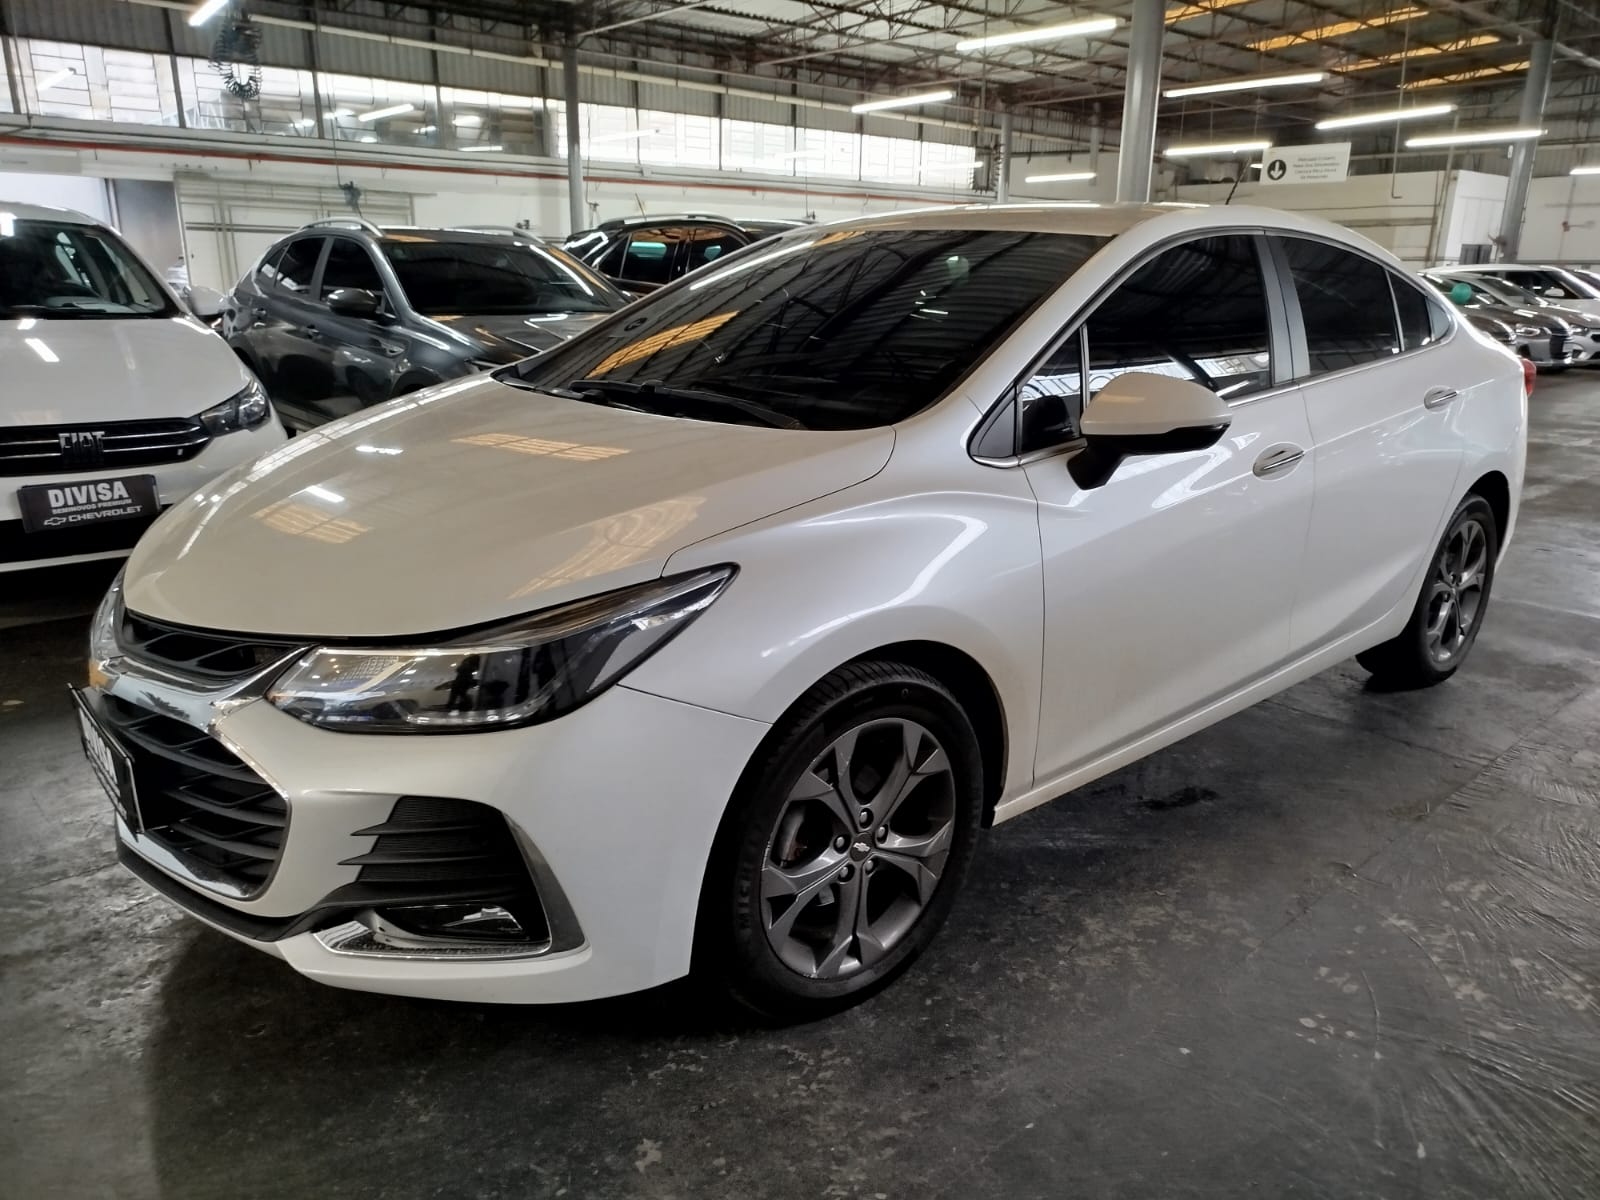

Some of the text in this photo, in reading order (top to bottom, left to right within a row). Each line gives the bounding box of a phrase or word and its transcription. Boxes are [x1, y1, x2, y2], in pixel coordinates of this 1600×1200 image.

[47, 481, 129, 508] DIVISA
[51, 498, 132, 515] SEMINOVOS PREMIUM
[68, 505, 143, 522] CHEVROLET
